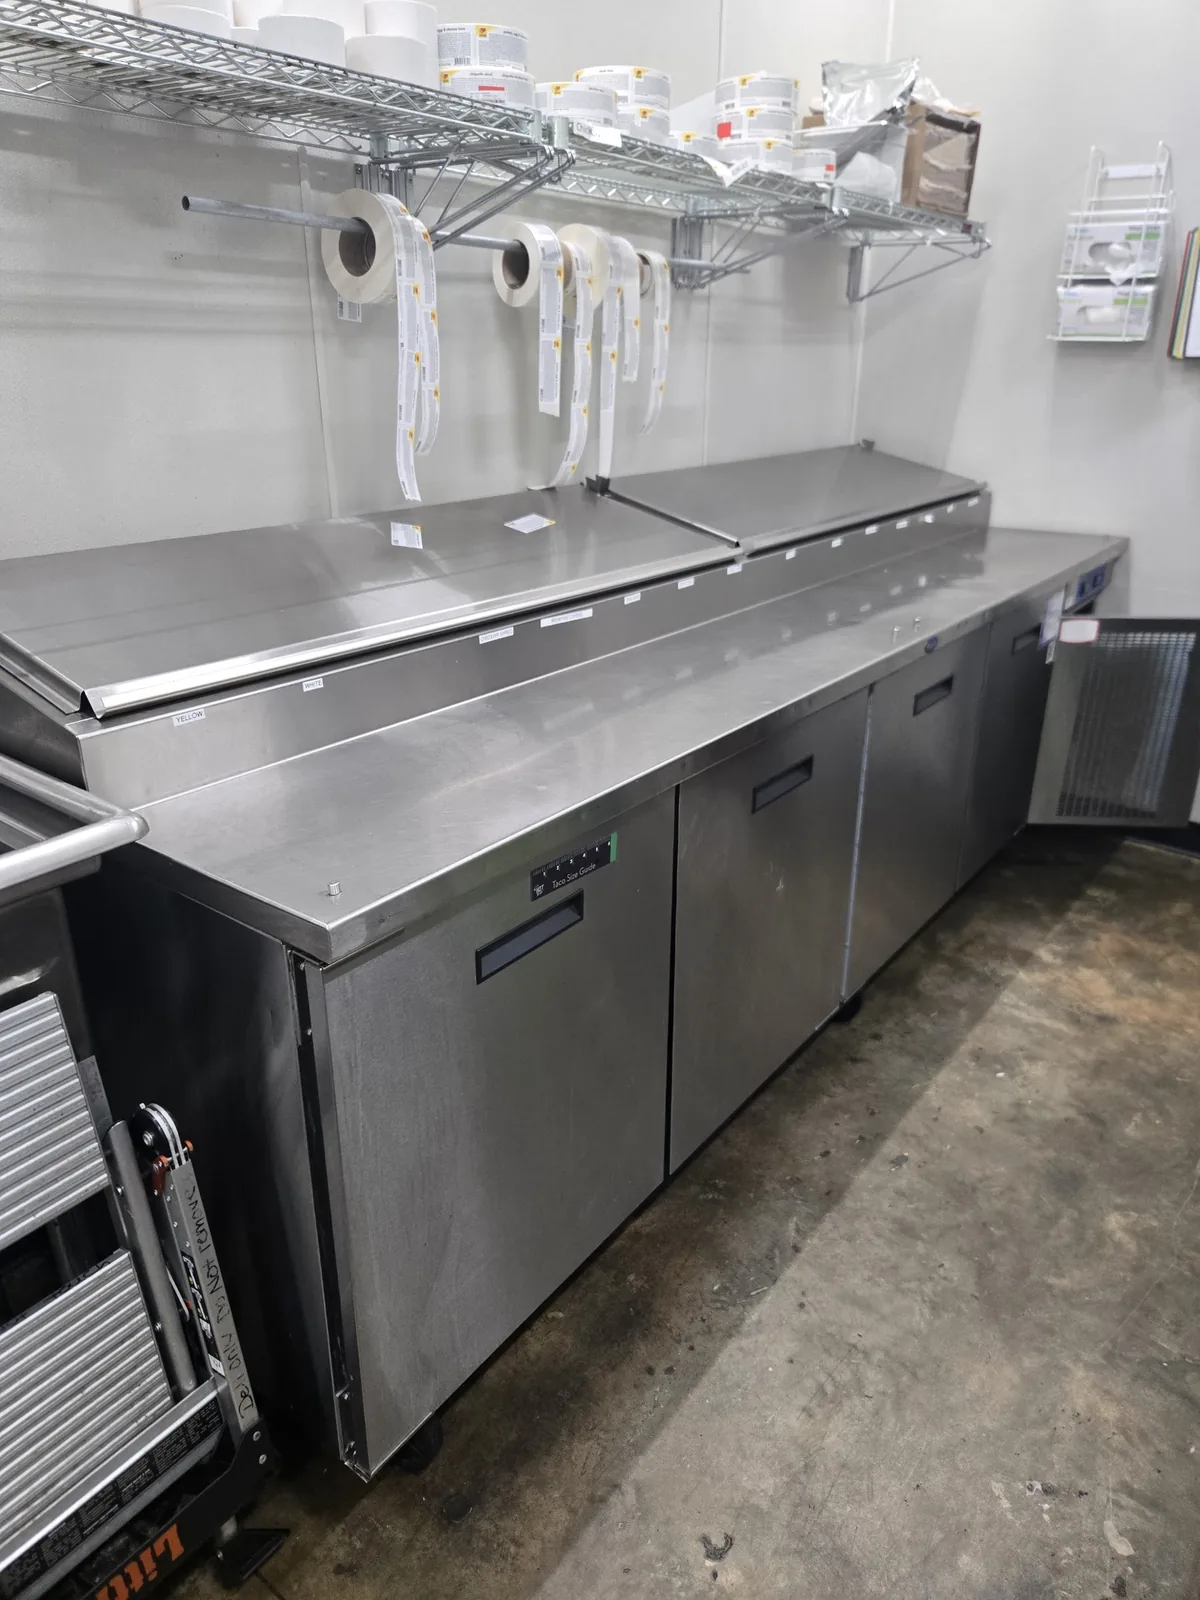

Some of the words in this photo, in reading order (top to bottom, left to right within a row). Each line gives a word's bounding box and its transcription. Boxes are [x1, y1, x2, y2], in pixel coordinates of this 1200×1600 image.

[304, 680, 322, 690] WHITE
[175, 710, 204, 724] YELLOW
[552, 877, 566, 889] Taco
[566, 871, 579, 882] Size
[579, 862, 597, 876] Guide
